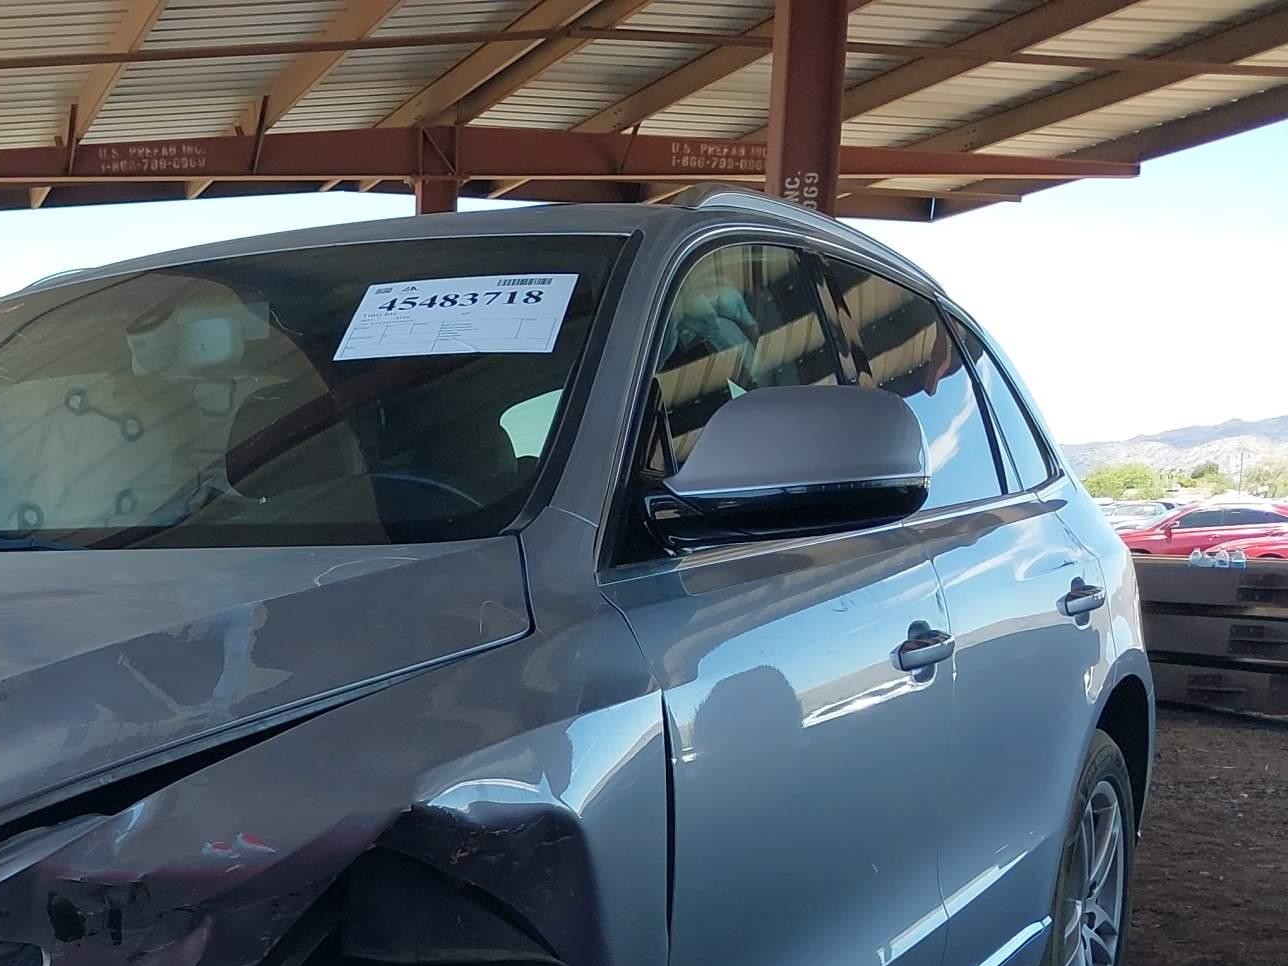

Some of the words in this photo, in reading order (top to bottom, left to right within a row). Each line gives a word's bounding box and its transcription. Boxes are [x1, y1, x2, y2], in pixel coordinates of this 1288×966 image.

[128, 144, 177, 158] PREFAB
[699, 143, 746, 158] PREFAB
[671, 155, 765, 171] 1-866-799-096
[784, 170, 800, 202] NC.
[378, 289, 544, 312] 45483718
